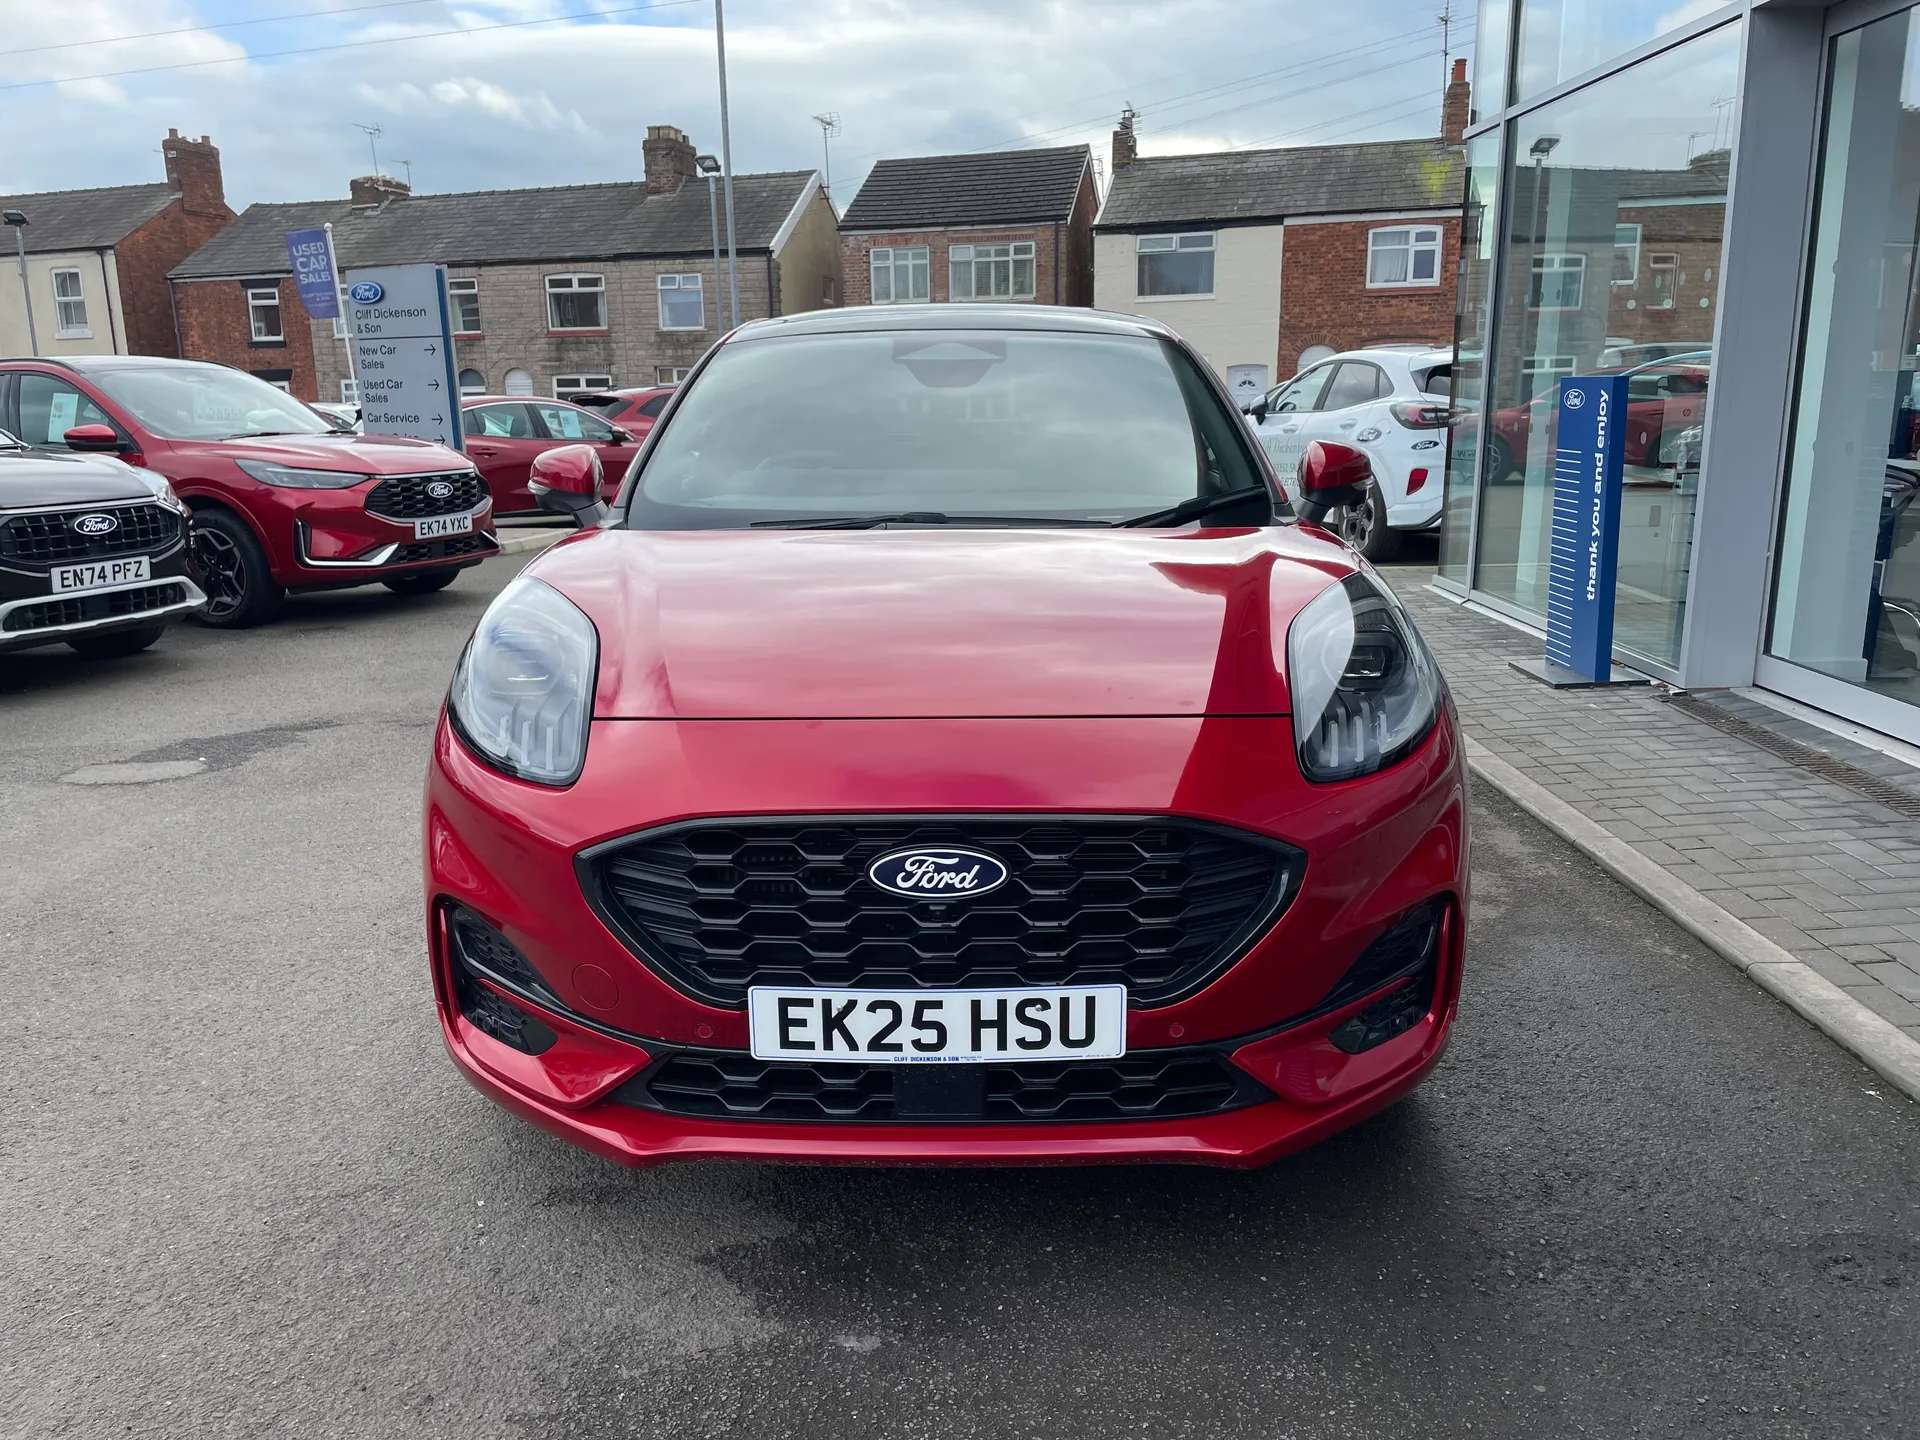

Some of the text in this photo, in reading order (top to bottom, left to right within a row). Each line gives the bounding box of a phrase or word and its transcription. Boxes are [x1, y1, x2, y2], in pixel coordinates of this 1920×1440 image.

[292, 241, 325, 257] USED
[296, 255, 328, 272] CAR
[355, 284, 376, 300] Ford
[355, 307, 427, 320] Cliff Dickenson
[357, 323, 382, 334] & Son
[360, 344, 397, 356] New Car
[361, 359, 385, 370] Sales
[363, 379, 403, 390] Used Car
[365, 392, 389, 403] Sales
[367, 412, 420, 424] Car Service
[1586, 389, 1609, 602] thank you and enjoy
[83, 517, 110, 532] Ford
[420, 516, 469, 536] EK74 YXC
[60, 560, 144, 589] EN74 PFZ
[895, 855, 980, 889] Ford
[777, 995, 1097, 1053] EK25 HSU
